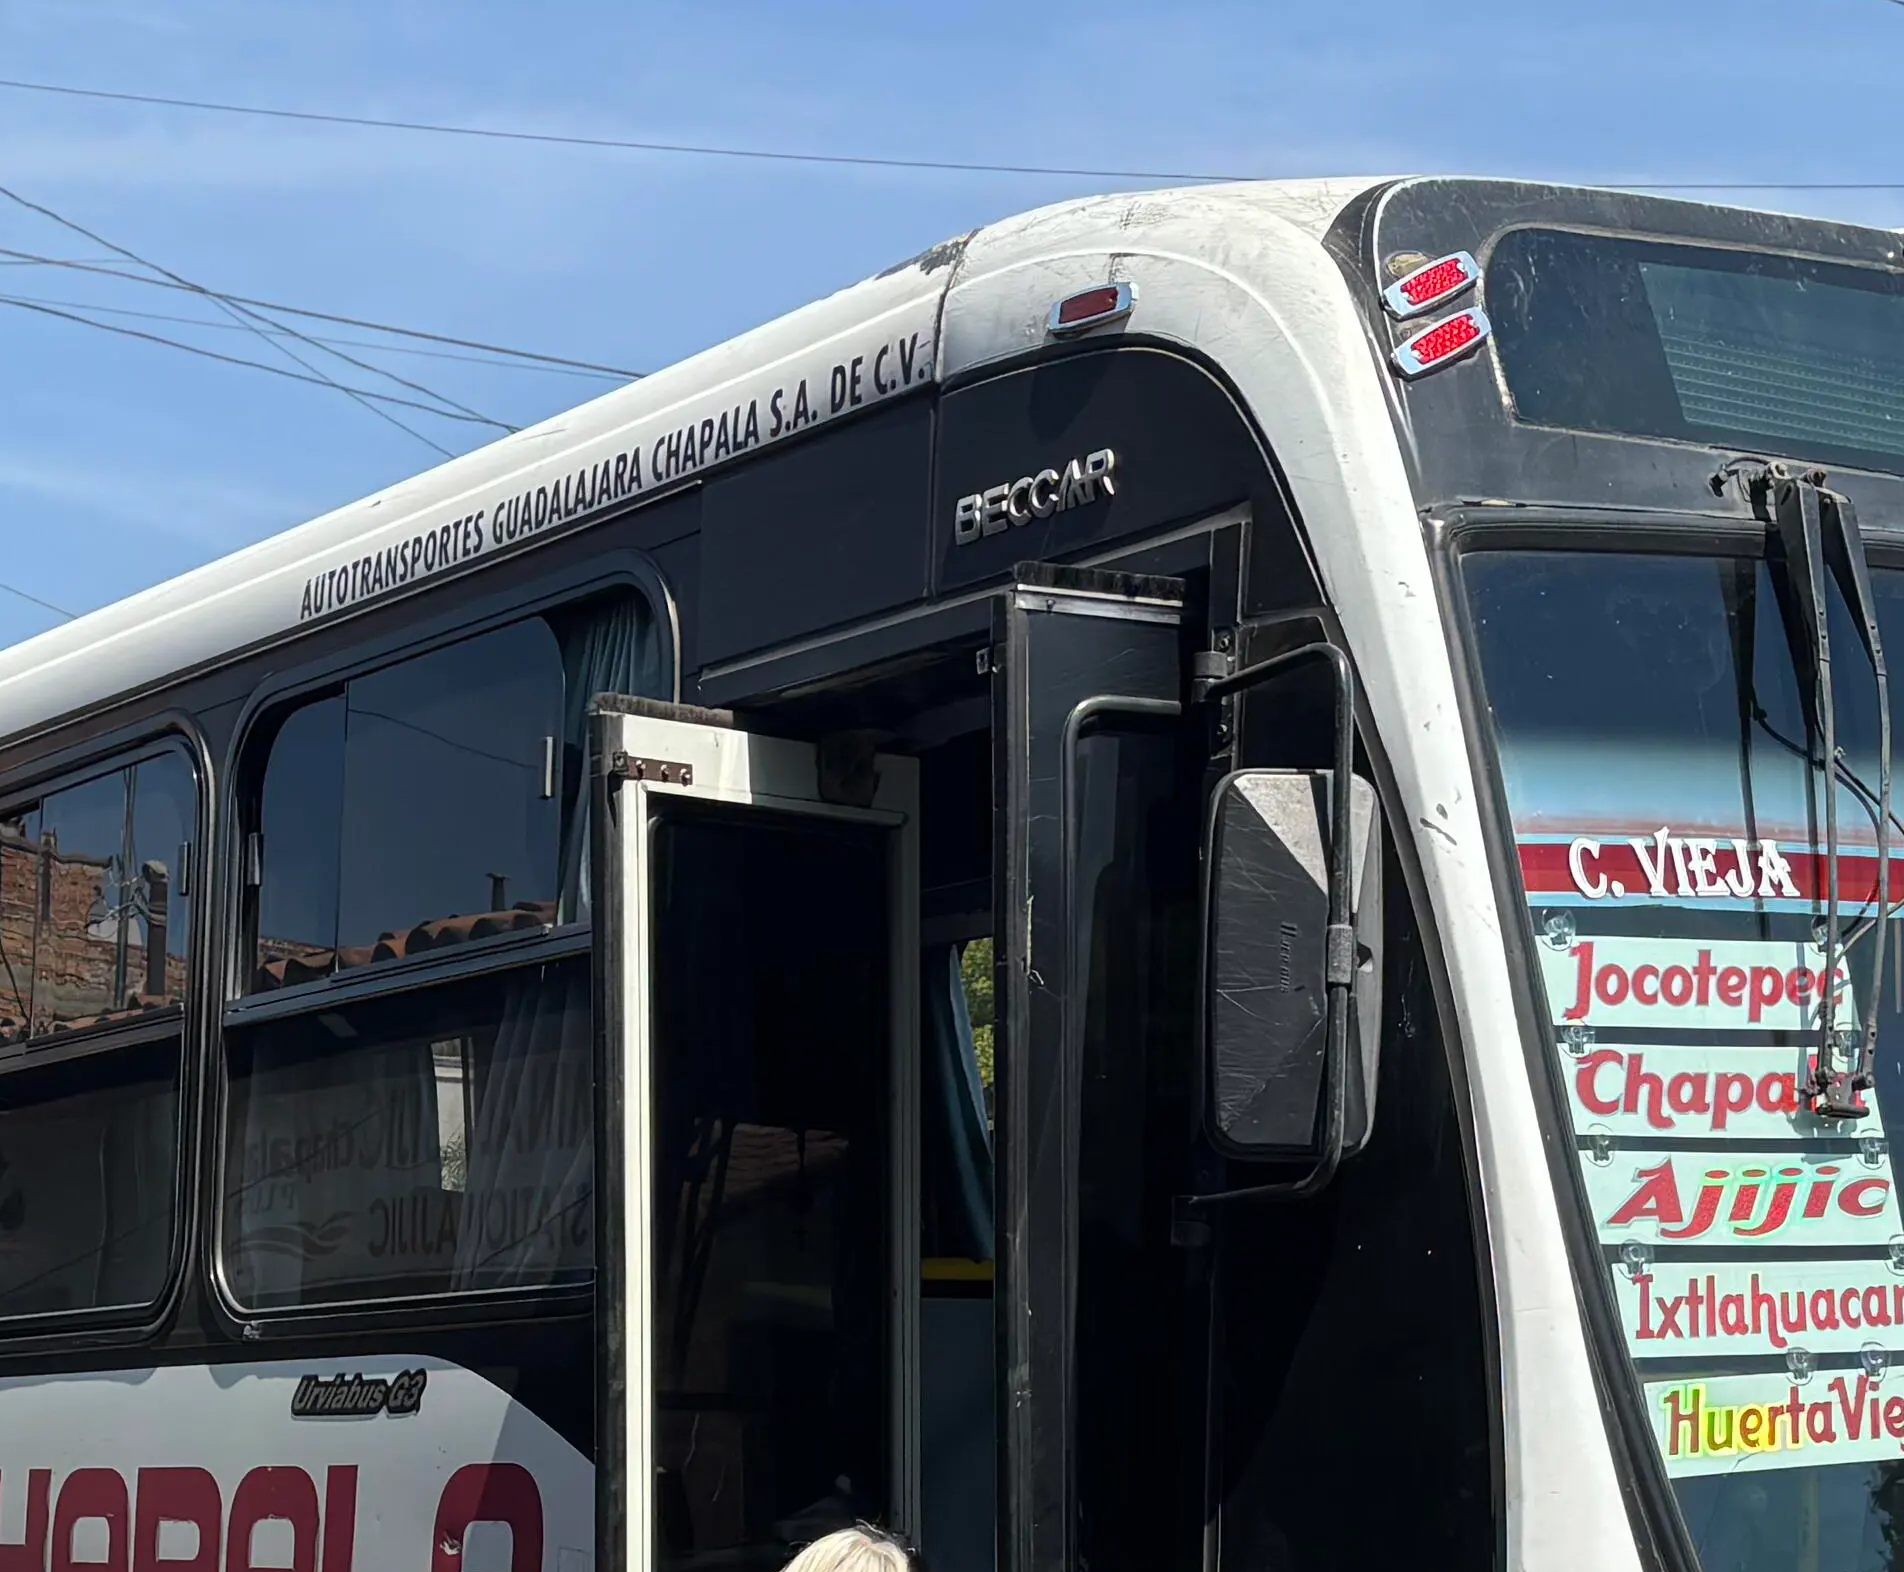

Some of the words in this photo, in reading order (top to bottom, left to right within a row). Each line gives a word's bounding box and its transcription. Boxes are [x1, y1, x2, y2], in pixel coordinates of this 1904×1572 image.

[301, 512, 485, 621] AUTOTRANSPORTES
[492, 446, 643, 546] GUADALAJARA
[652, 398, 759, 481] CHAPALA
[770, 386, 817, 439] S.A.
[830, 355, 863, 415] DE
[874, 332, 926, 396] C.V.
[955, 448, 1117, 546] BECCAR
[1568, 837, 1625, 900] C.
[1635, 825, 1801, 899] VIEJA
[1565, 941, 1844, 1023] Jocotepec
[1607, 1156, 1889, 1238] Ajijic
